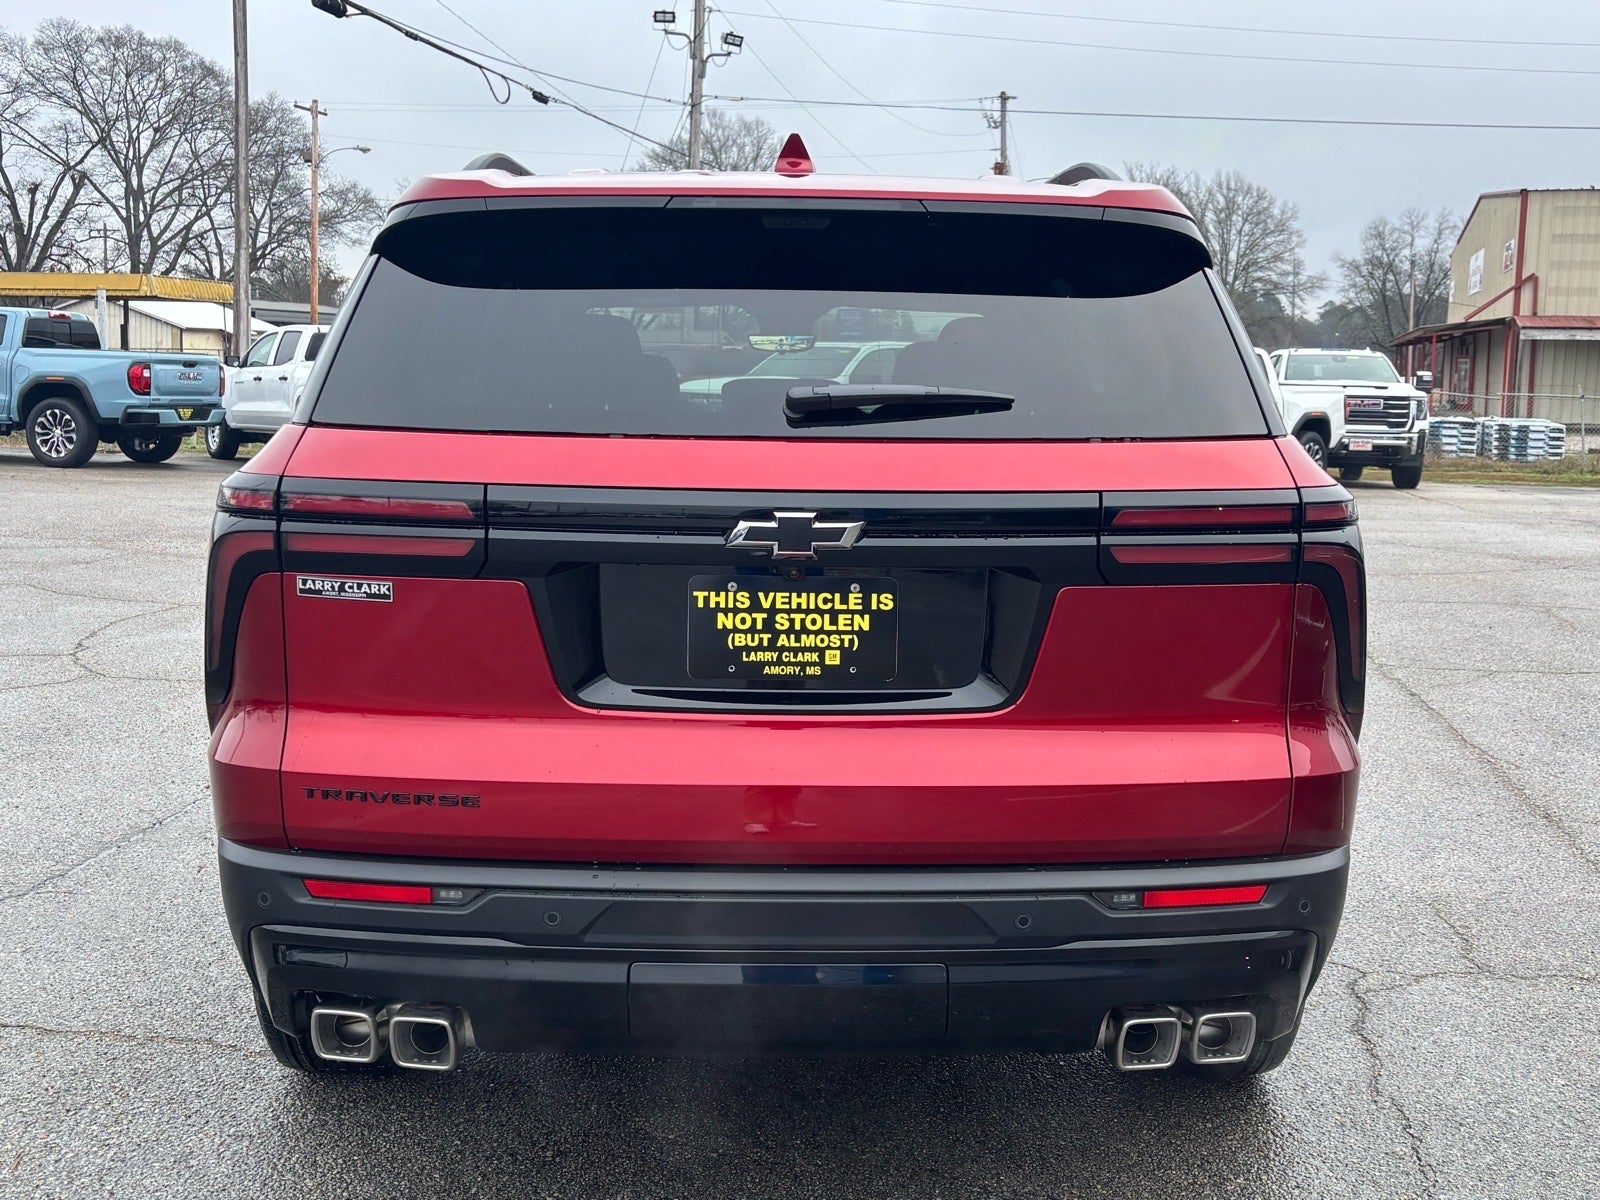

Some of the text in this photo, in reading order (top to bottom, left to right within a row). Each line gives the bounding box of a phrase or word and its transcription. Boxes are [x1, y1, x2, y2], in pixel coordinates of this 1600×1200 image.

[299, 579, 390, 595] LARRY CLARK
[693, 591, 894, 610] THIS VEHICLE IS
[717, 612, 870, 631] NOT STOLEN
[727, 633, 859, 651] (BUT ALMOST)
[742, 651, 779, 662] LARRY
[782, 652, 820, 663] CLARK
[763, 666, 821, 676] AMORY, MS
[301, 786, 481, 808] TRAVERSE
